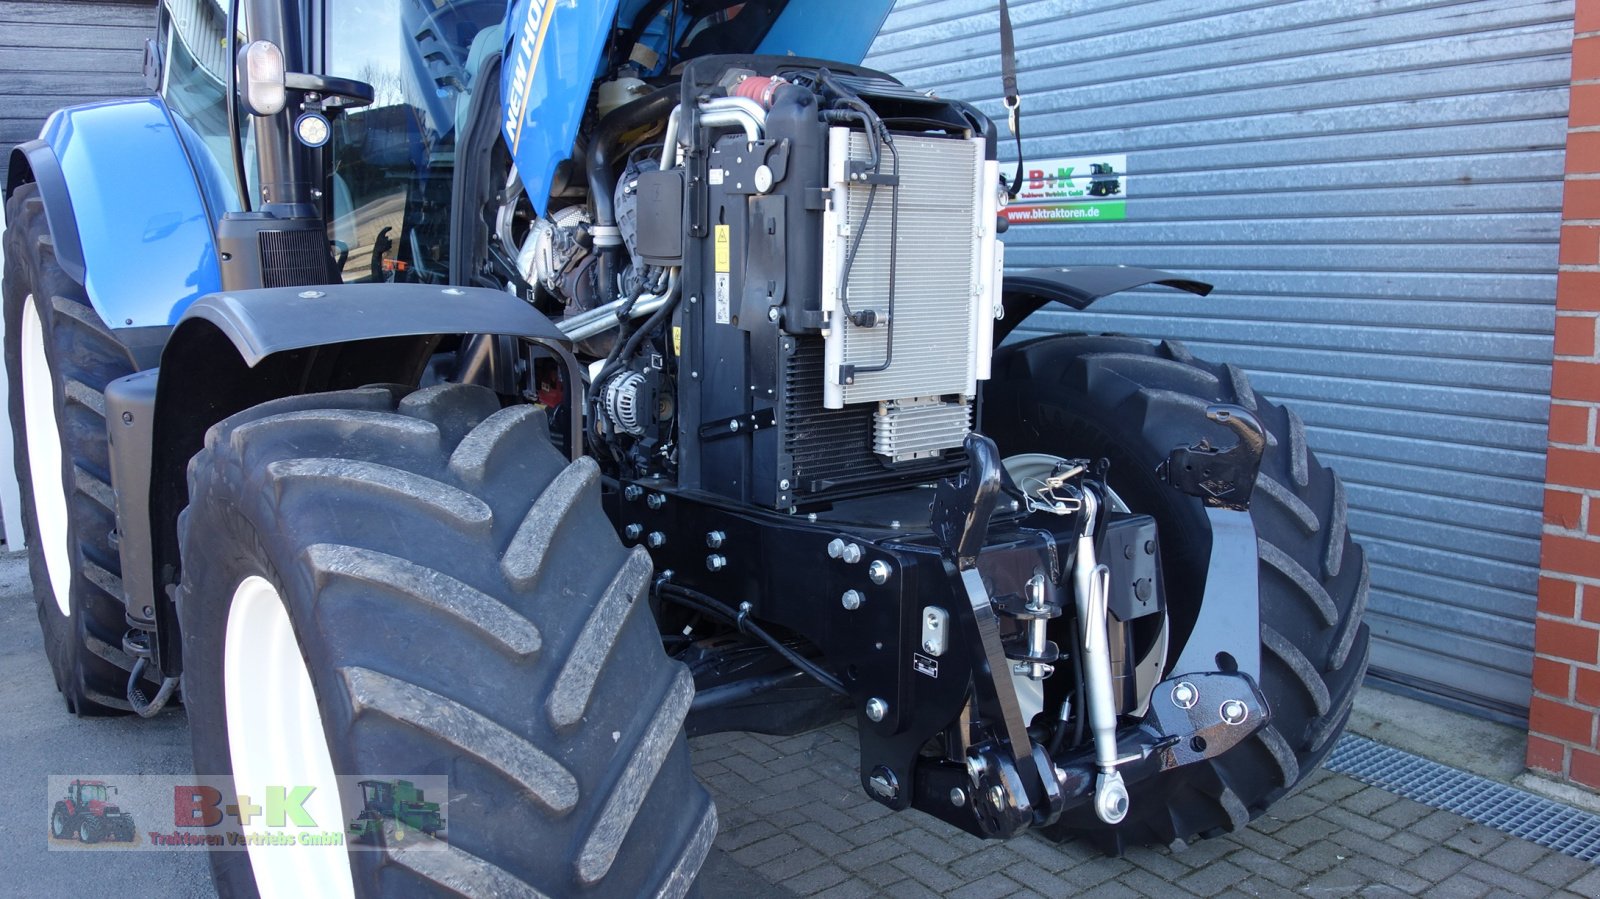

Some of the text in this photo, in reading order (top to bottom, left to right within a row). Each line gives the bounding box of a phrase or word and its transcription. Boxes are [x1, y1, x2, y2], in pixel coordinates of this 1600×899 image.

[505, 0, 547, 143] NEW HO
[1029, 167, 1075, 189] B+K
[1008, 207, 1099, 220] www.bktraktoren.de
